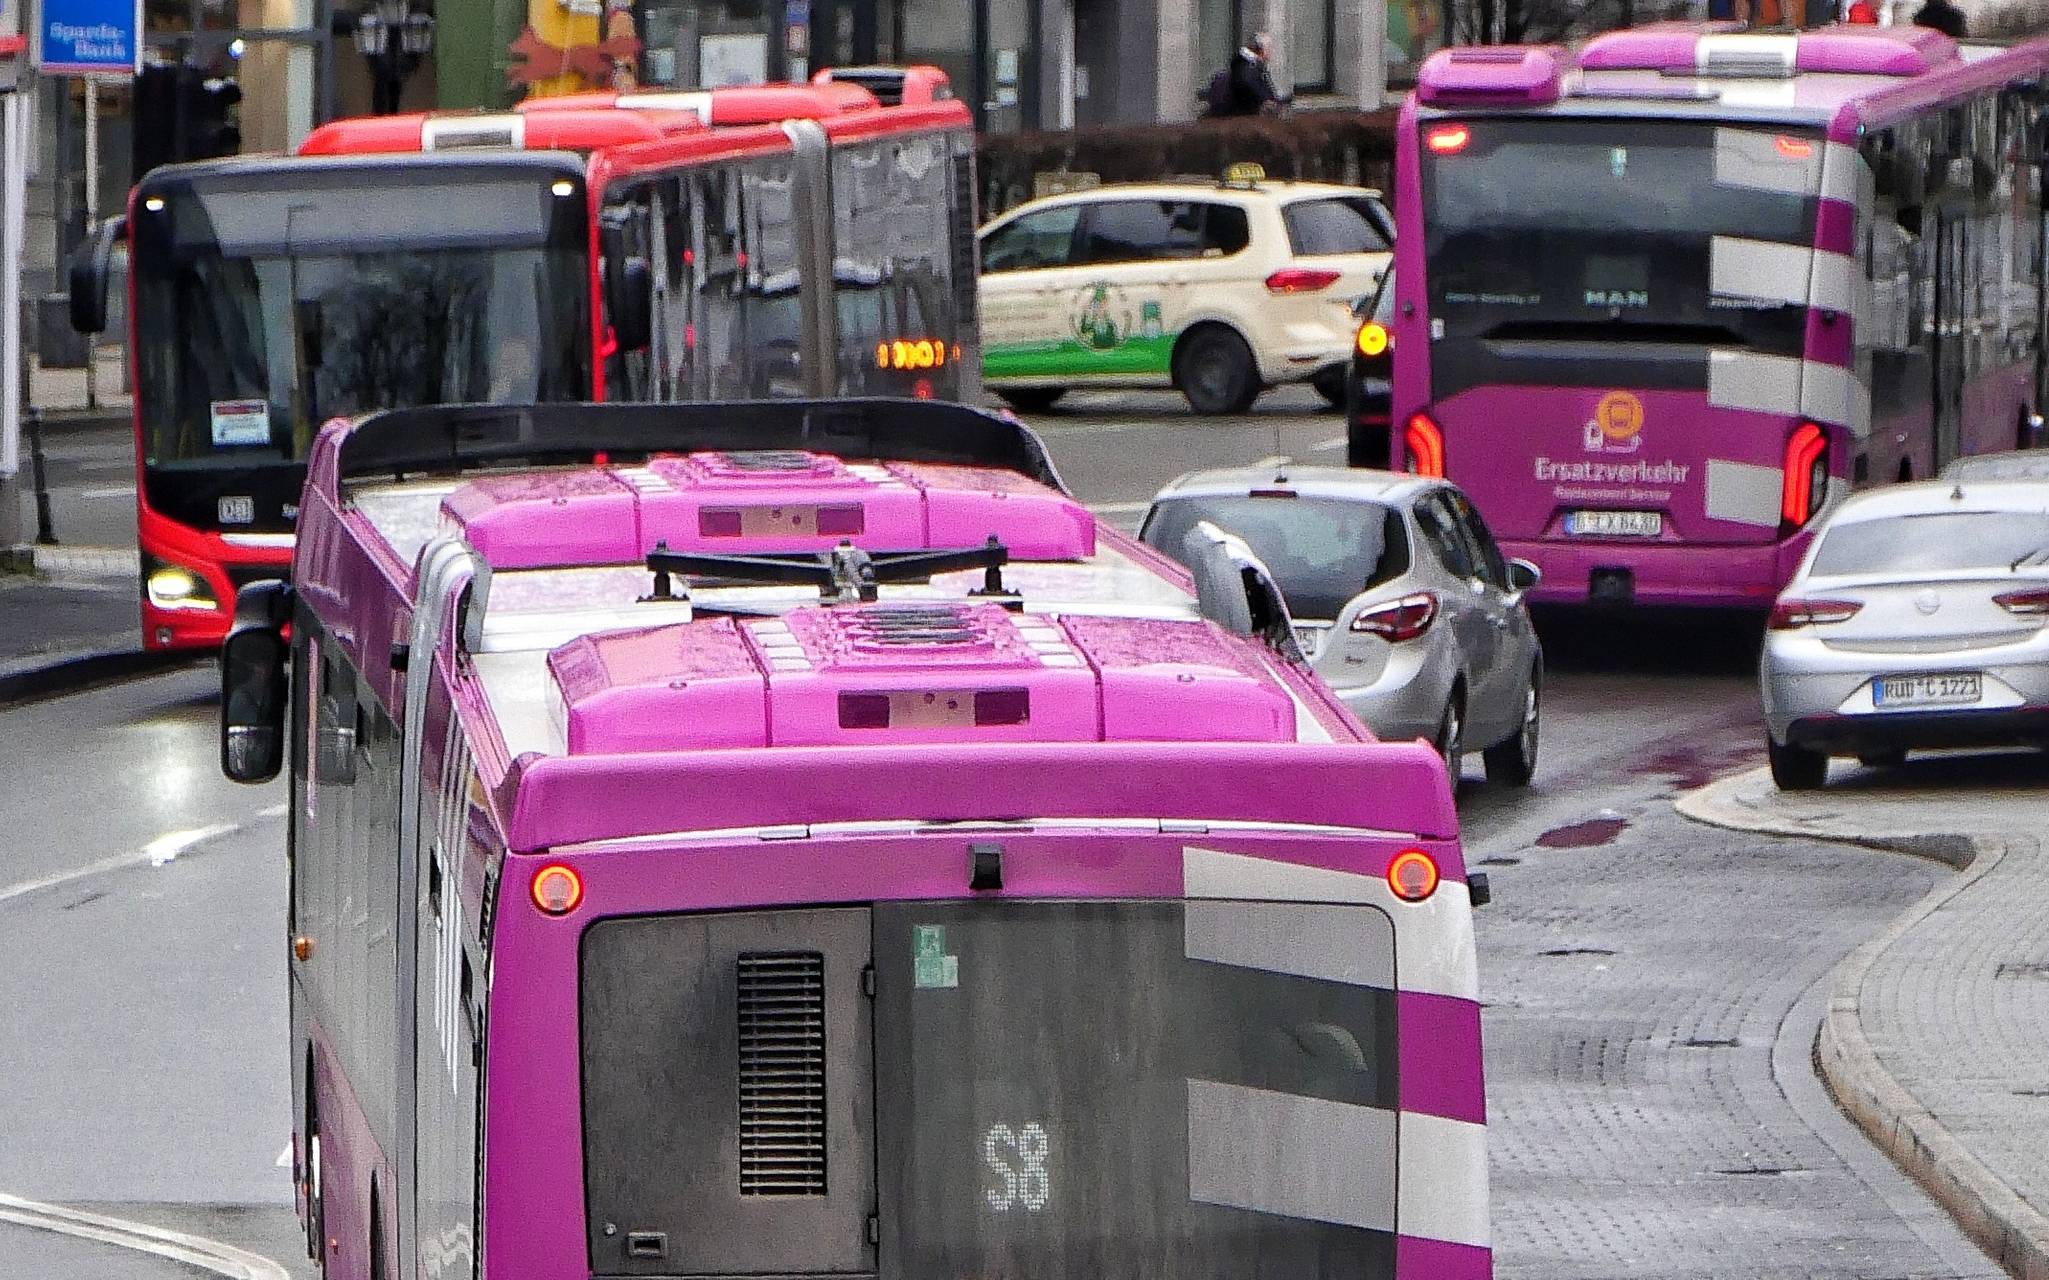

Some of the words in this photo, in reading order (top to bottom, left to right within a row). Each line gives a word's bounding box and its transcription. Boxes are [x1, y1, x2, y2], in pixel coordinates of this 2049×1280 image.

[75, 40, 126, 58] Bank
[1585, 290, 1649, 306] MAN
[1534, 457, 1690, 483] Ersatzverkehr
[1884, 680, 1915, 698] RUD
[986, 1124, 1048, 1211] S8
